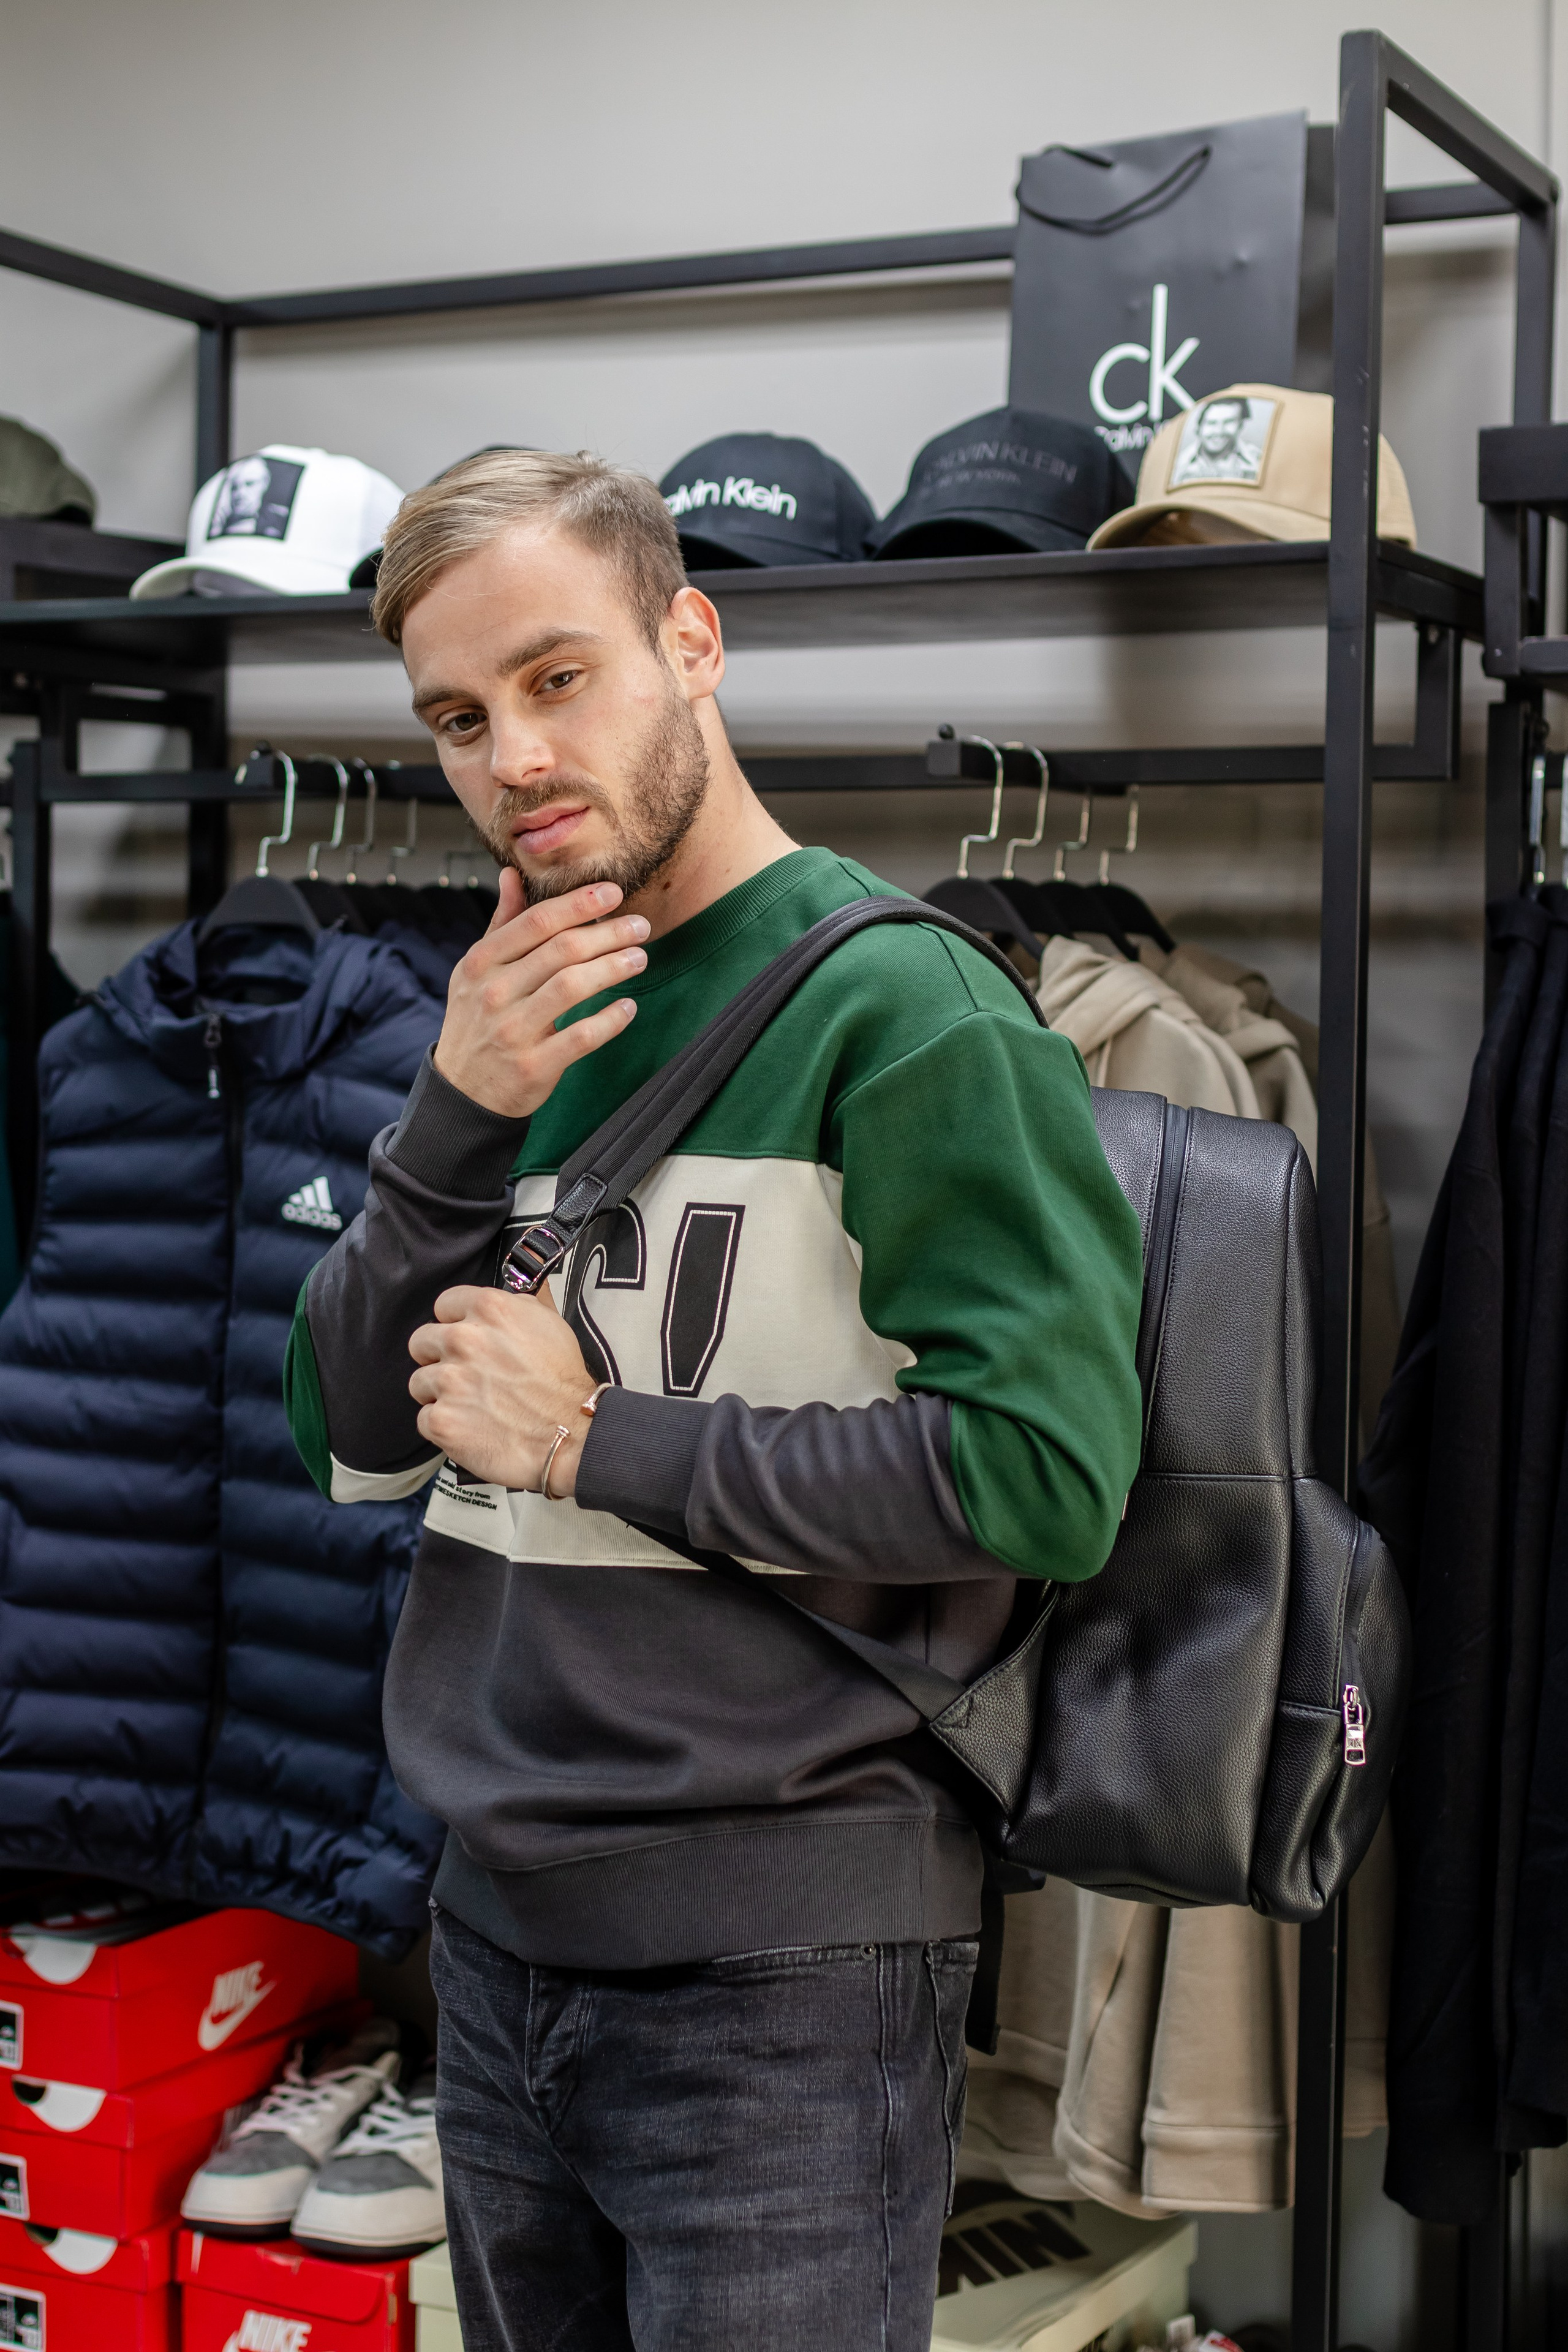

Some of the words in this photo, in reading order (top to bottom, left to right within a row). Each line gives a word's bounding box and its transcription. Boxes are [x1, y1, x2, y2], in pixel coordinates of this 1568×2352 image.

[1089, 283, 1200, 424] ck
[664, 478, 721, 516] alvin
[723, 476, 797, 520] Klein
[281, 1202, 342, 1231] adidas
[456, 1487, 474, 1497] story
[475, 1491, 491, 1499] from
[472, 1499, 497, 1510] DESIGN
[210, 1960, 265, 2017] NIKE
[238, 2309, 312, 2352] NIKE
